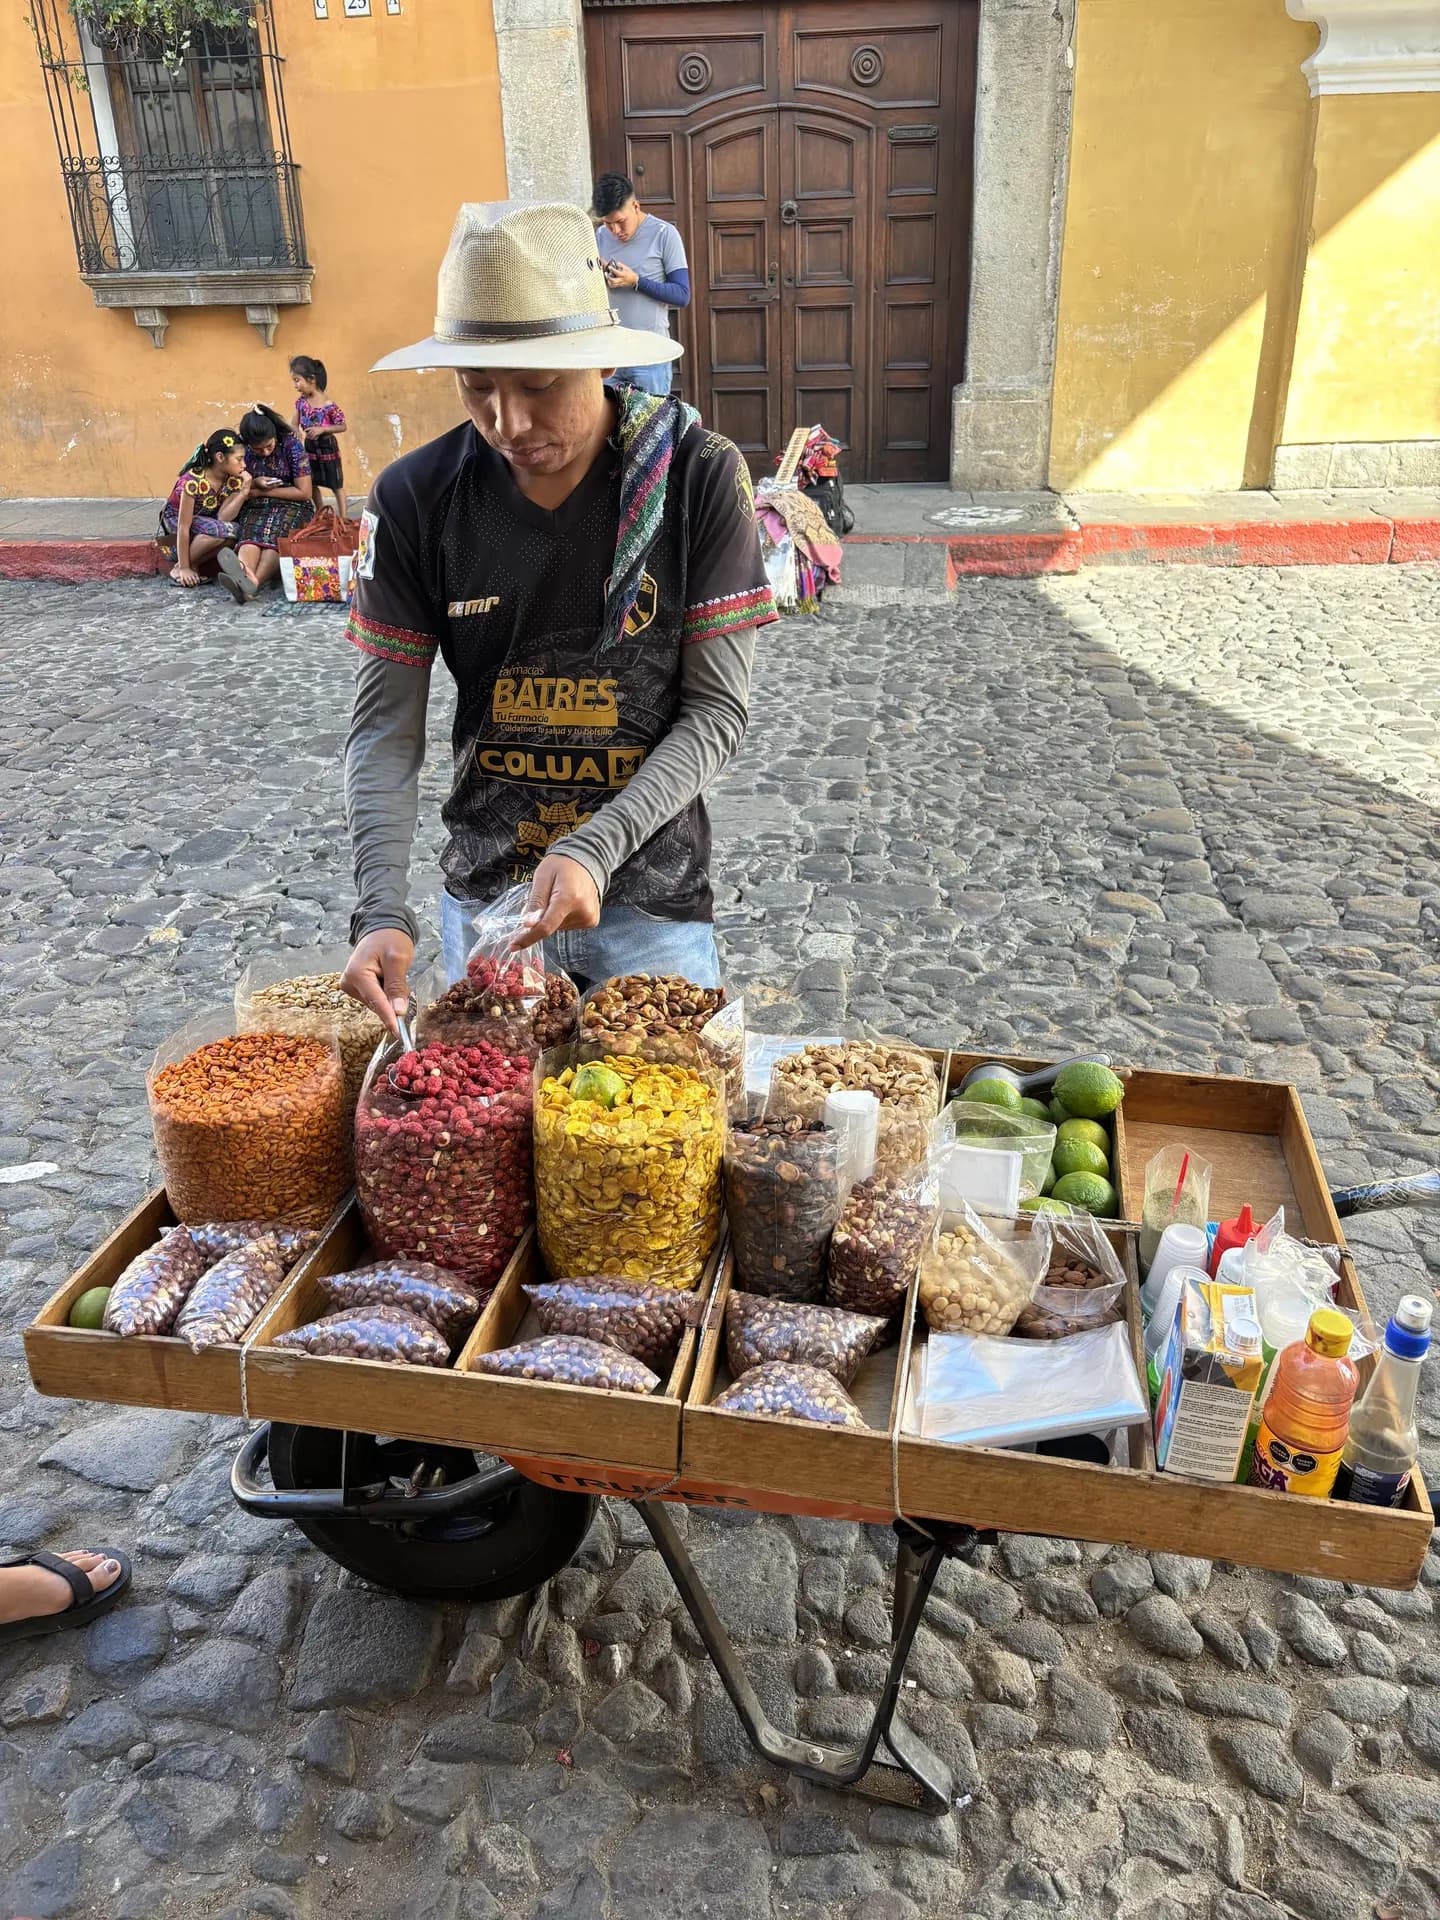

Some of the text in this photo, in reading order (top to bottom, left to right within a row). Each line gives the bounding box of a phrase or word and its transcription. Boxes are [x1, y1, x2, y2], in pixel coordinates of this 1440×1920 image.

[493, 678, 618, 712] BATRES
[495, 712, 549, 723] Tu Farmacia
[480, 750, 605, 782] COLUA
